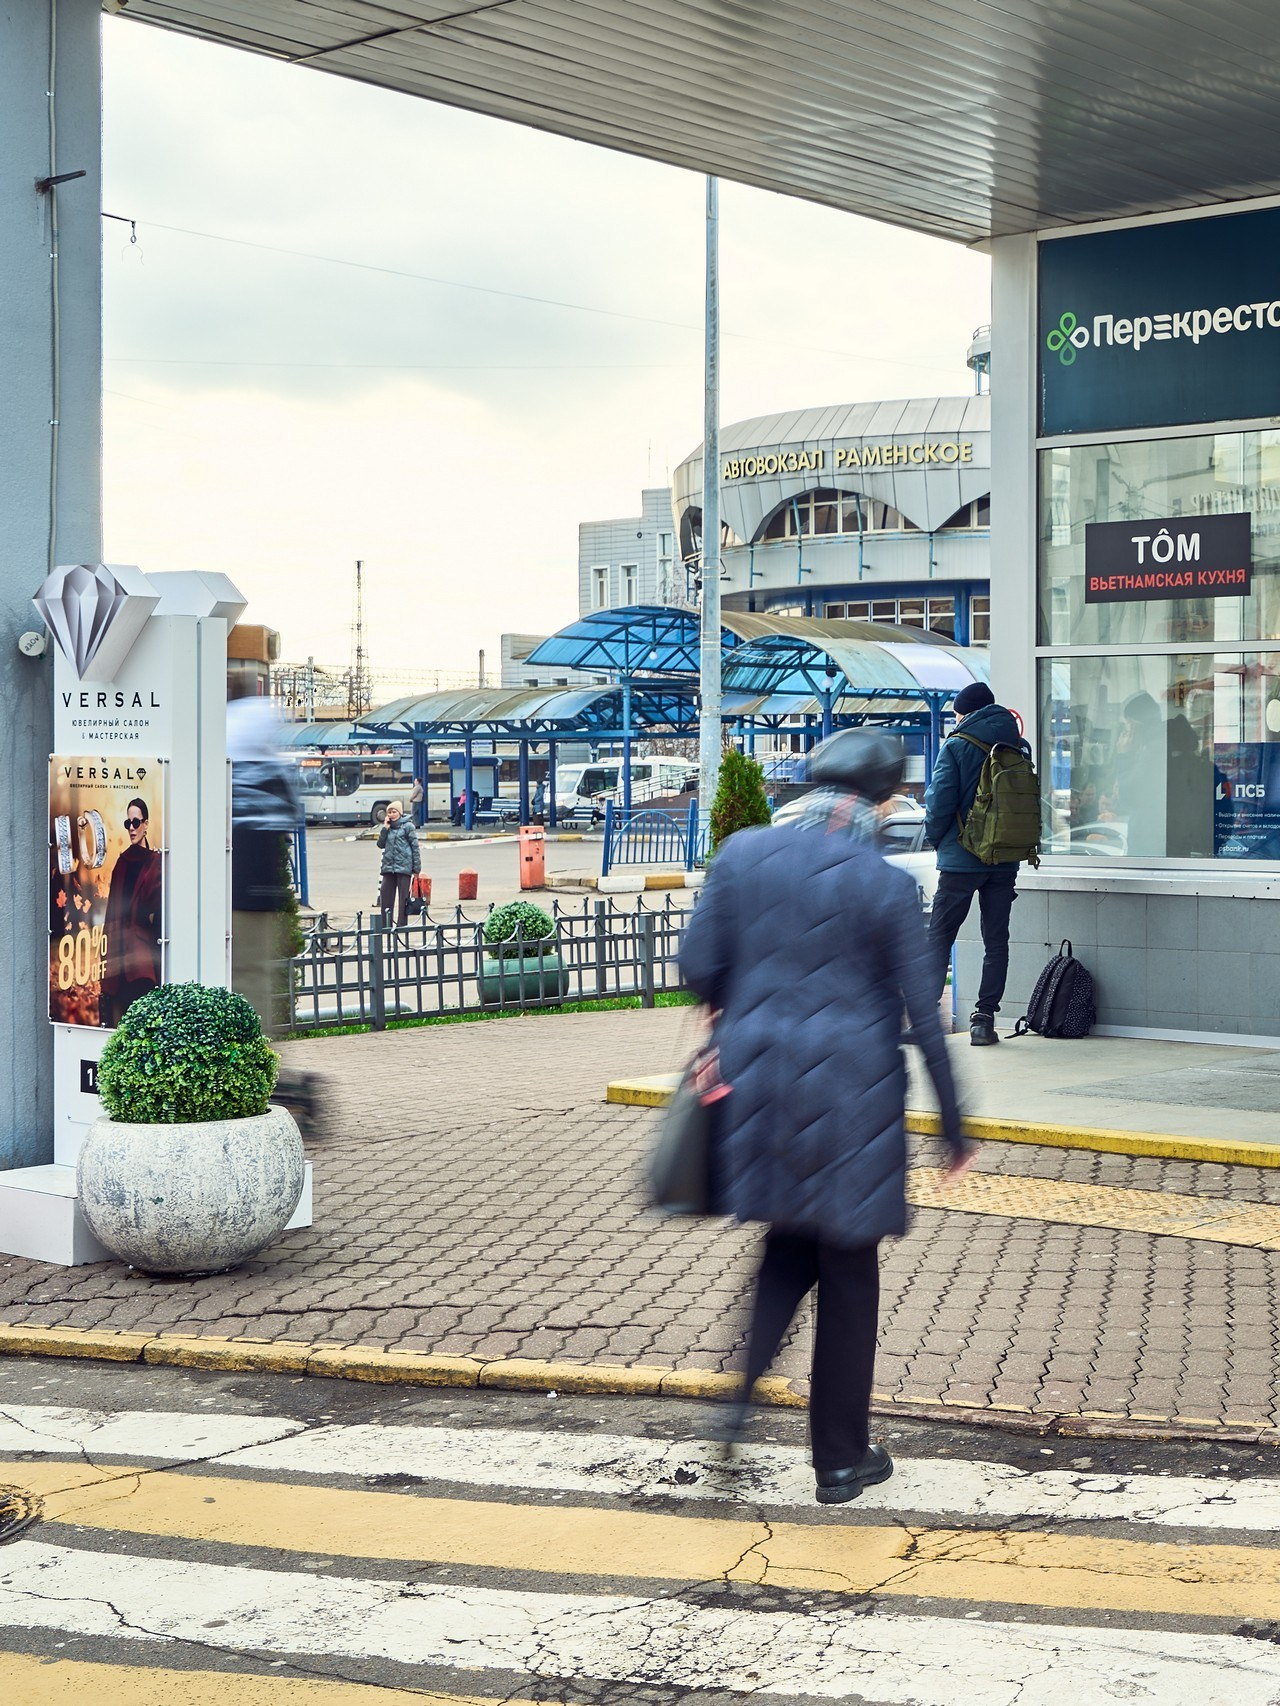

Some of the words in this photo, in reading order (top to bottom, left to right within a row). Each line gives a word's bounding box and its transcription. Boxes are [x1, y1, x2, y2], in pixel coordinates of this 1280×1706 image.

[723, 450, 824, 480] АВТОВОКЗАЛ
[835, 442, 972, 469] РАМЕНСКОЕ
[1090, 571, 1193, 591] ВЬЕТНАМСКАЯ
[1198, 568, 1246, 586] КУХНЯ
[62, 692, 160, 708] VERSAL
[72, 718, 120, 727] ЮВЕЛИРНЫЙ
[123, 719, 150, 727] САЛОН
[88, 732, 140, 740] МАСТЕРСКАЯ
[65, 767, 134, 780] VERSAL
[1235, 784, 1265, 798] ПСБ
[1218, 845, 1249, 853] psbank.ru
[58, 923, 108, 990] 80%
[92, 960, 108, 982] OFF
